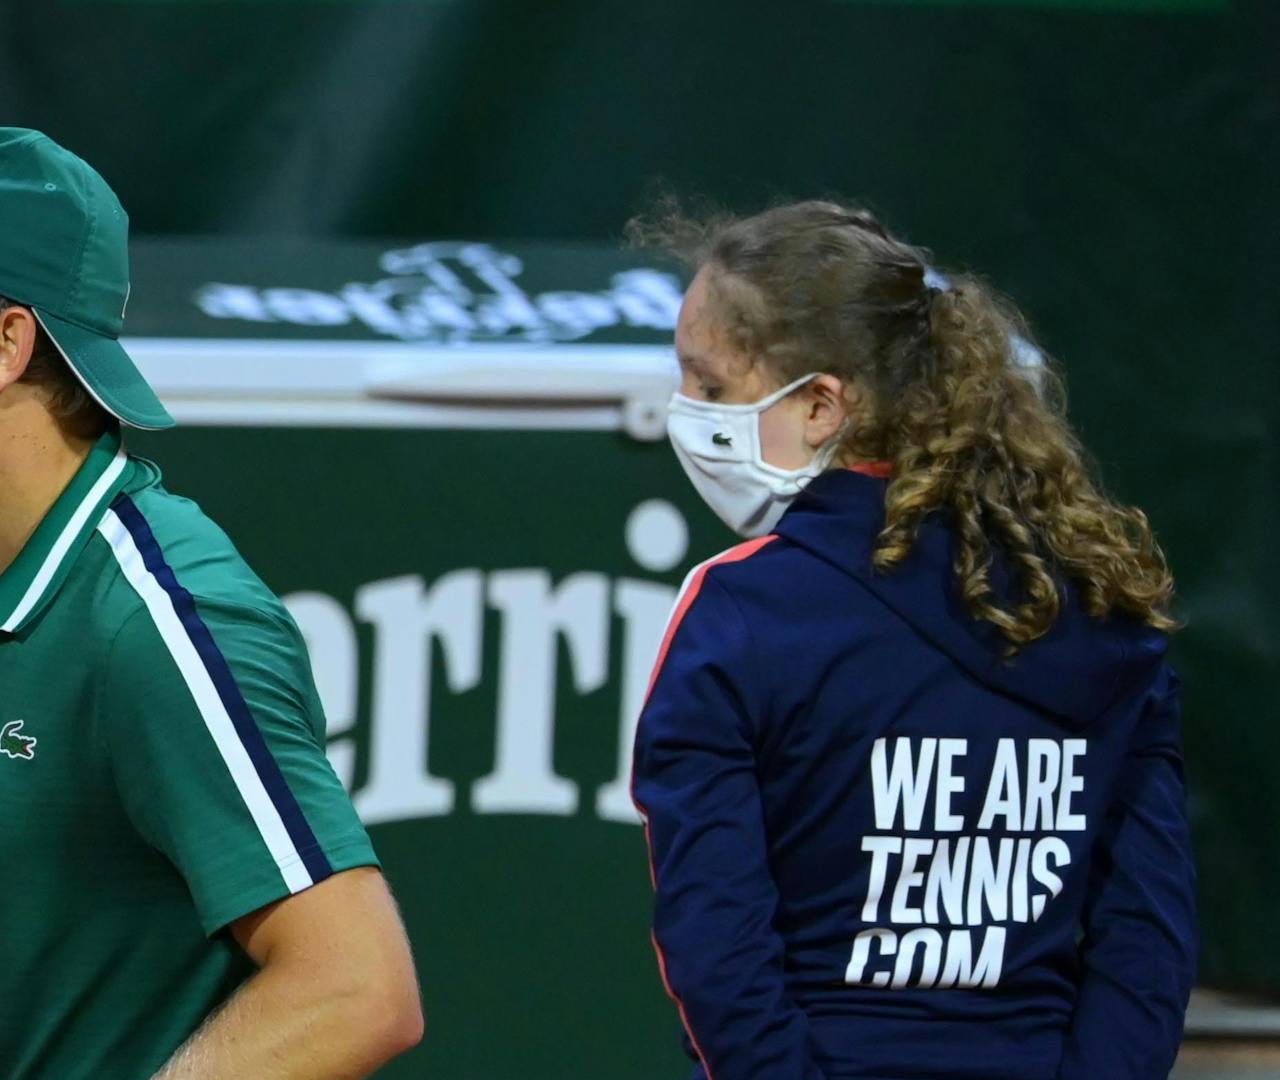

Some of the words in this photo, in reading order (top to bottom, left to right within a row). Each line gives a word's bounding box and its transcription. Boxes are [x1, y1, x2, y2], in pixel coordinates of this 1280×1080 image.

[870, 736, 968, 832] WE
[976, 737, 1088, 832] ARE
[860, 835, 1072, 926] TENNIS
